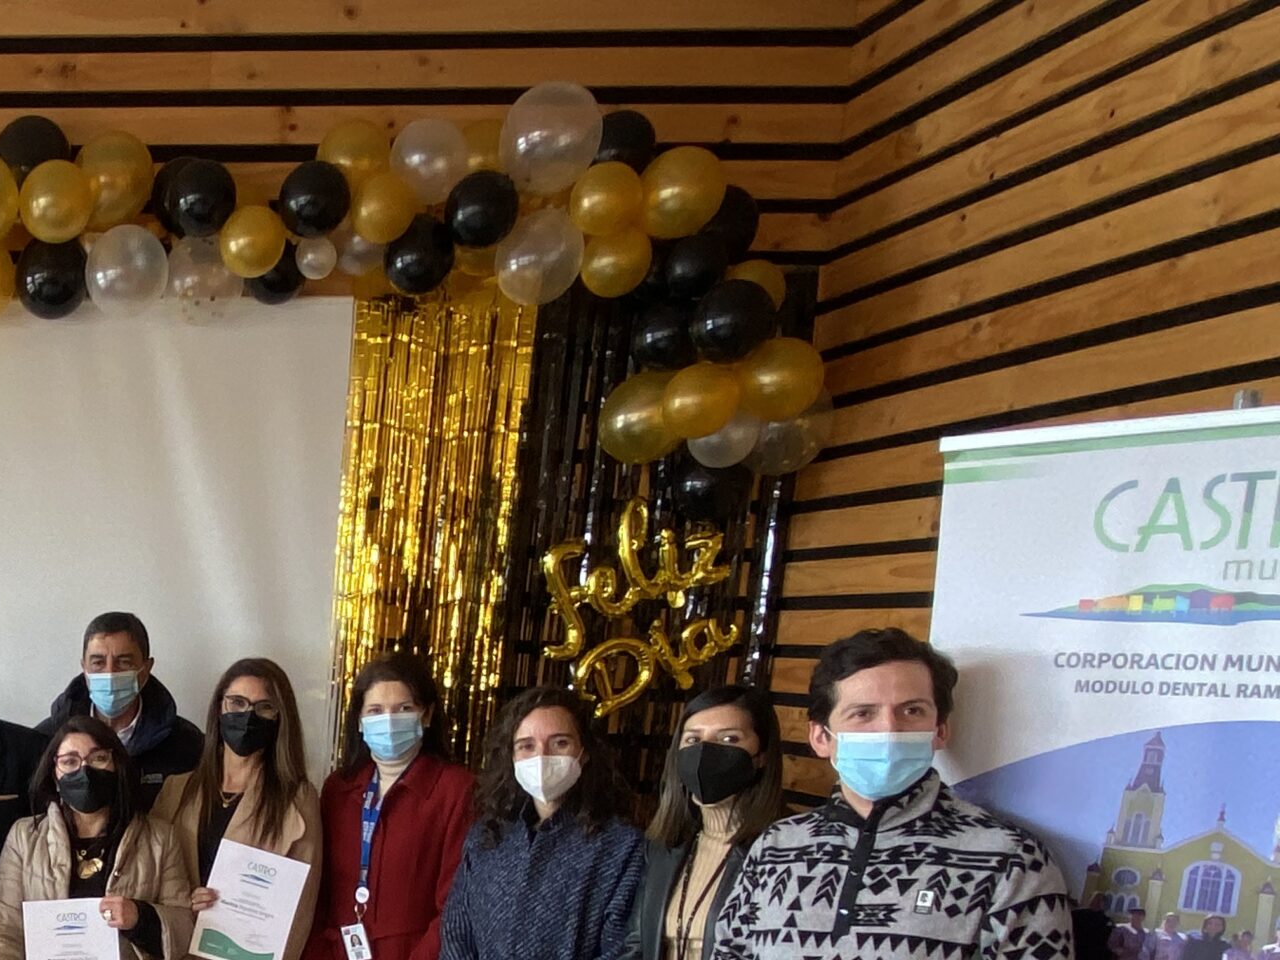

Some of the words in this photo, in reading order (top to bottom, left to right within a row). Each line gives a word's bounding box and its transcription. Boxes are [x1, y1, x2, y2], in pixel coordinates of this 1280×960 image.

[1053, 651, 1218, 671] CORPORACION
[1222, 654, 1280, 673] MUN
[1074, 679, 1154, 696] MODULO
[1158, 681, 1231, 698] DENTAL
[1236, 683, 1280, 699] RAM
[246, 861, 278, 877] CASTRO
[56, 912, 87, 923] CASTRO
